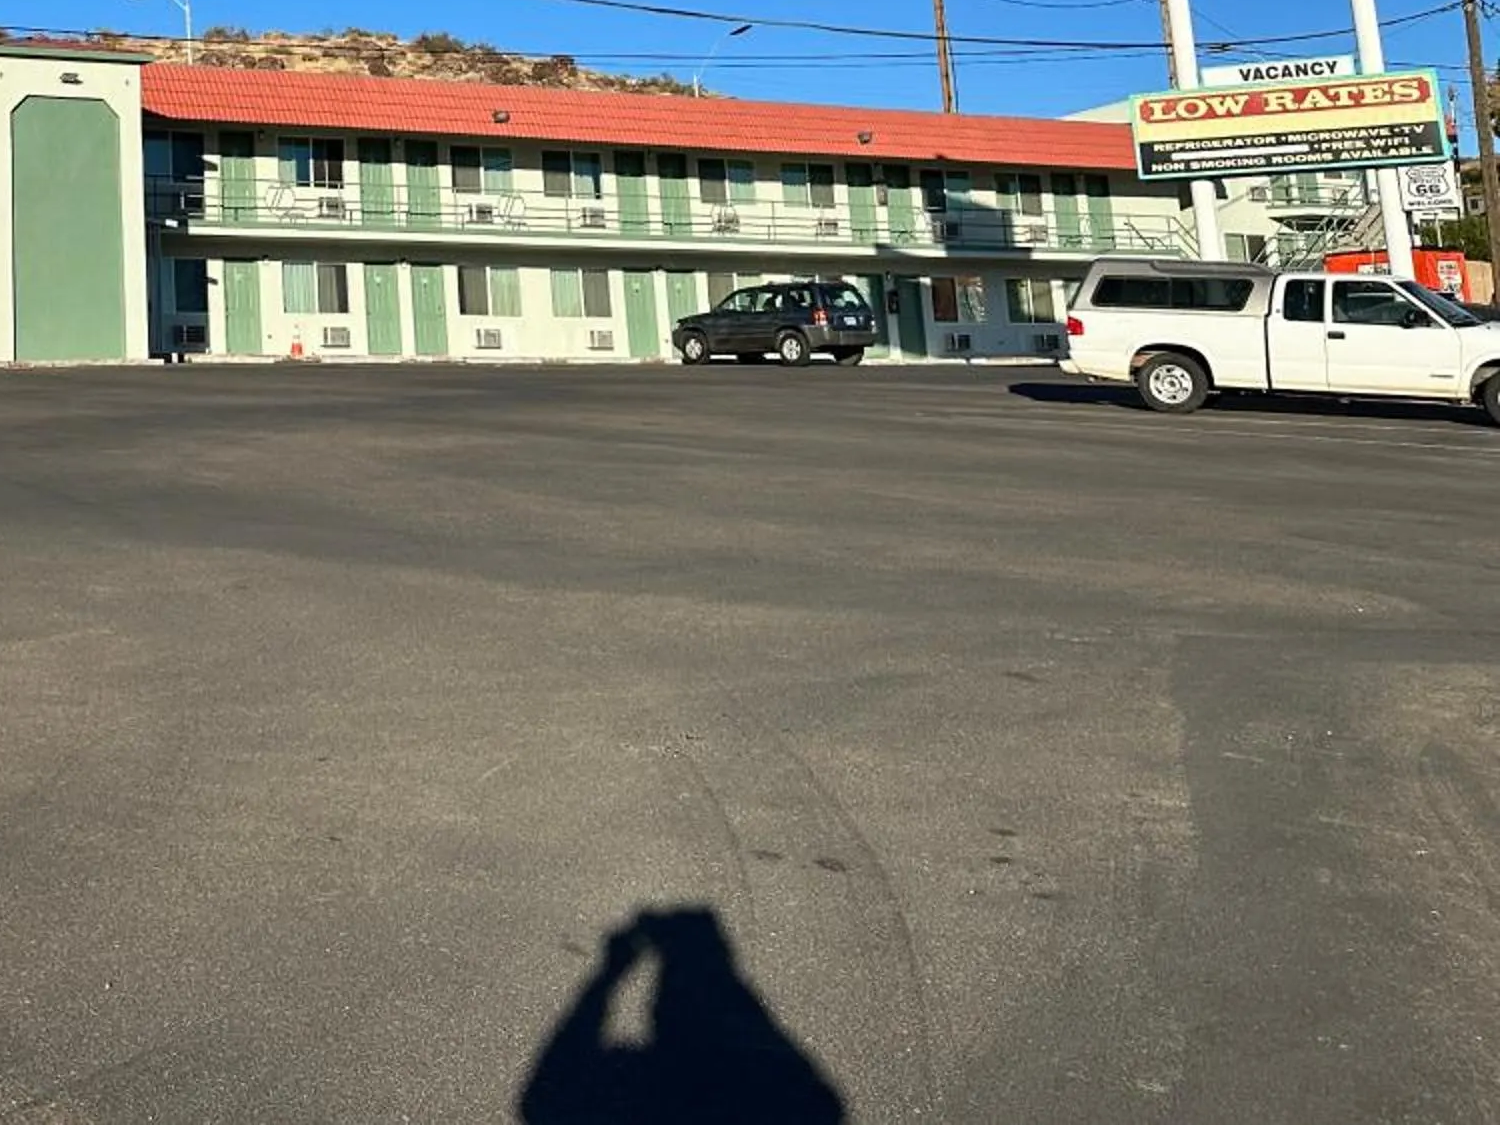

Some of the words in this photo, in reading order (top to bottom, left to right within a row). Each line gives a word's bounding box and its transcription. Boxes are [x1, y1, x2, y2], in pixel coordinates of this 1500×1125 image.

[1238, 60, 1338, 82] VACANCY
[1150, 94, 1250, 120] LOW
[1263, 79, 1422, 113] RATES
[1153, 136, 1277, 152] REFRIGERATOR
[1402, 124, 1425, 134] TV
[1321, 139, 1367, 151] FREE
[1370, 136, 1410, 148] WIFI
[1151, 161, 1185, 173] NON
[1189, 156, 1267, 171] SMOKING
[1271, 152, 1334, 165] ROOMS
[1340, 145, 1434, 160] AVAILABLE
[1415, 184, 1441, 194] 66
